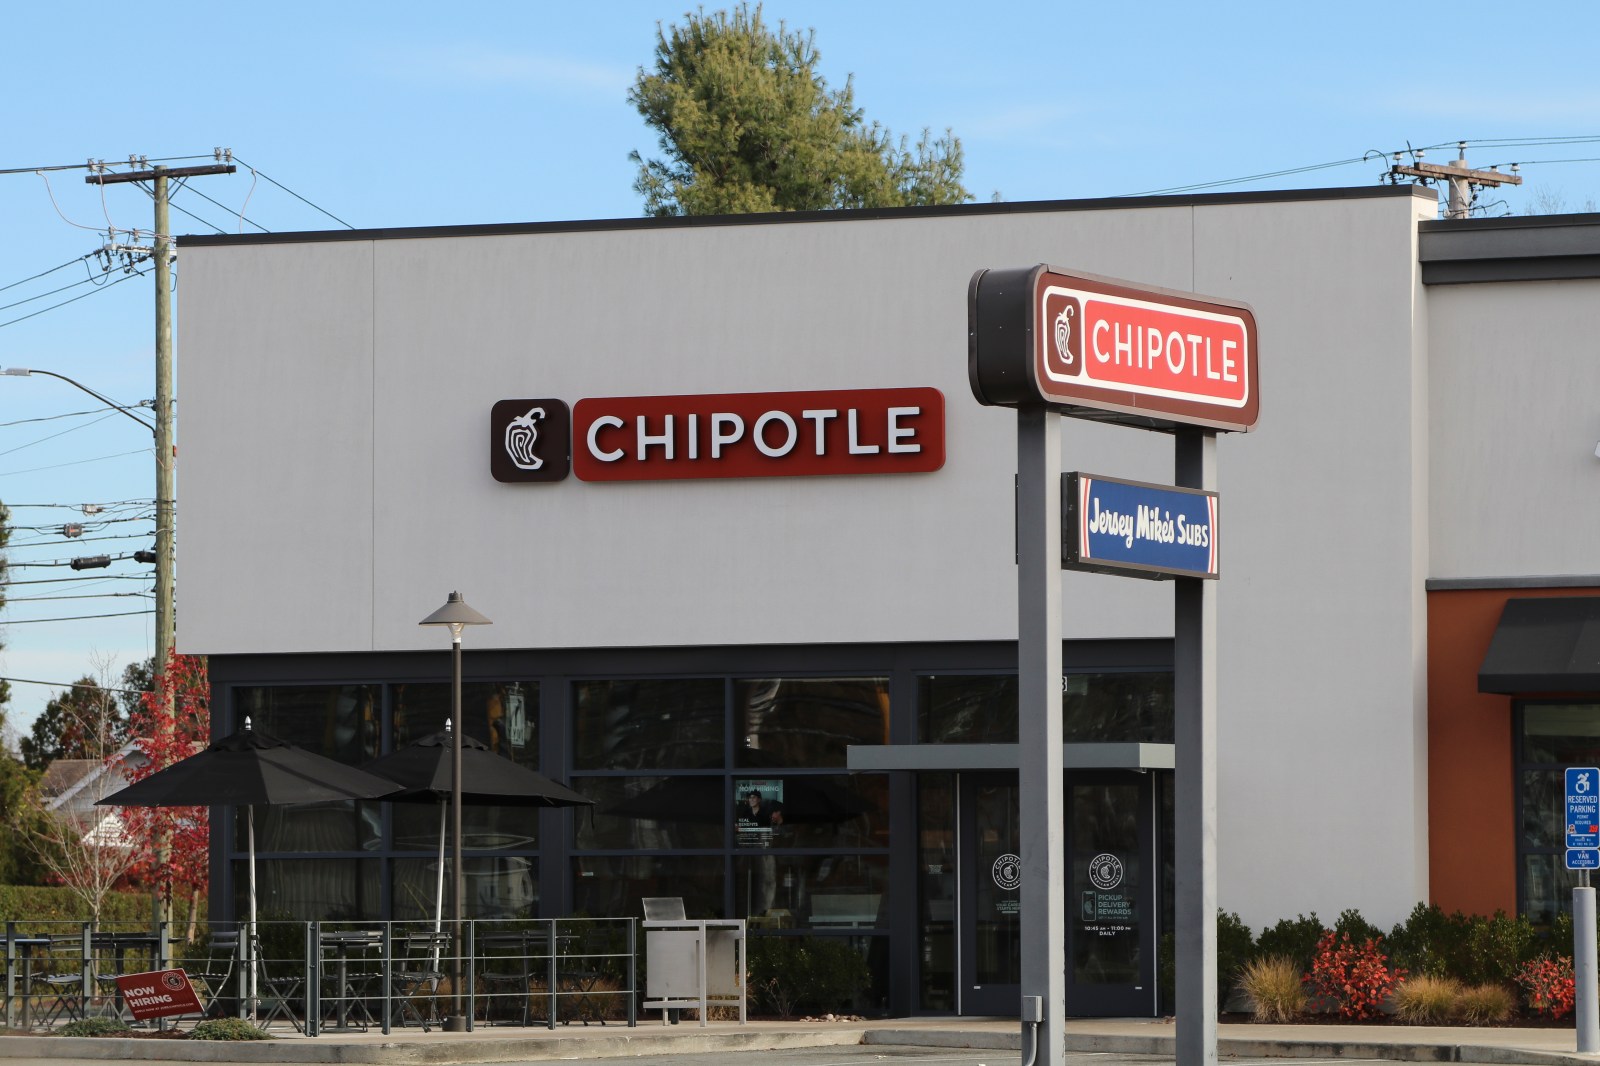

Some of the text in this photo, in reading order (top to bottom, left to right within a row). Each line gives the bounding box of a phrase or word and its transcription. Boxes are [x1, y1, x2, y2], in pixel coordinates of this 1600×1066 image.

[1093, 319, 1238, 383] CHIPOTLE
[586, 406, 921, 462] CHIPOTLE
[1089, 497, 1134, 549] Jersey
[1136, 504, 1175, 545] Mike's
[1568, 796, 1598, 804] RESERVED
[1570, 805, 1596, 813] PARKING
[1092, 855, 1121, 870] CHIPOTLE
[124, 986, 155, 998] NOW
[129, 994, 173, 1008] HIRING
